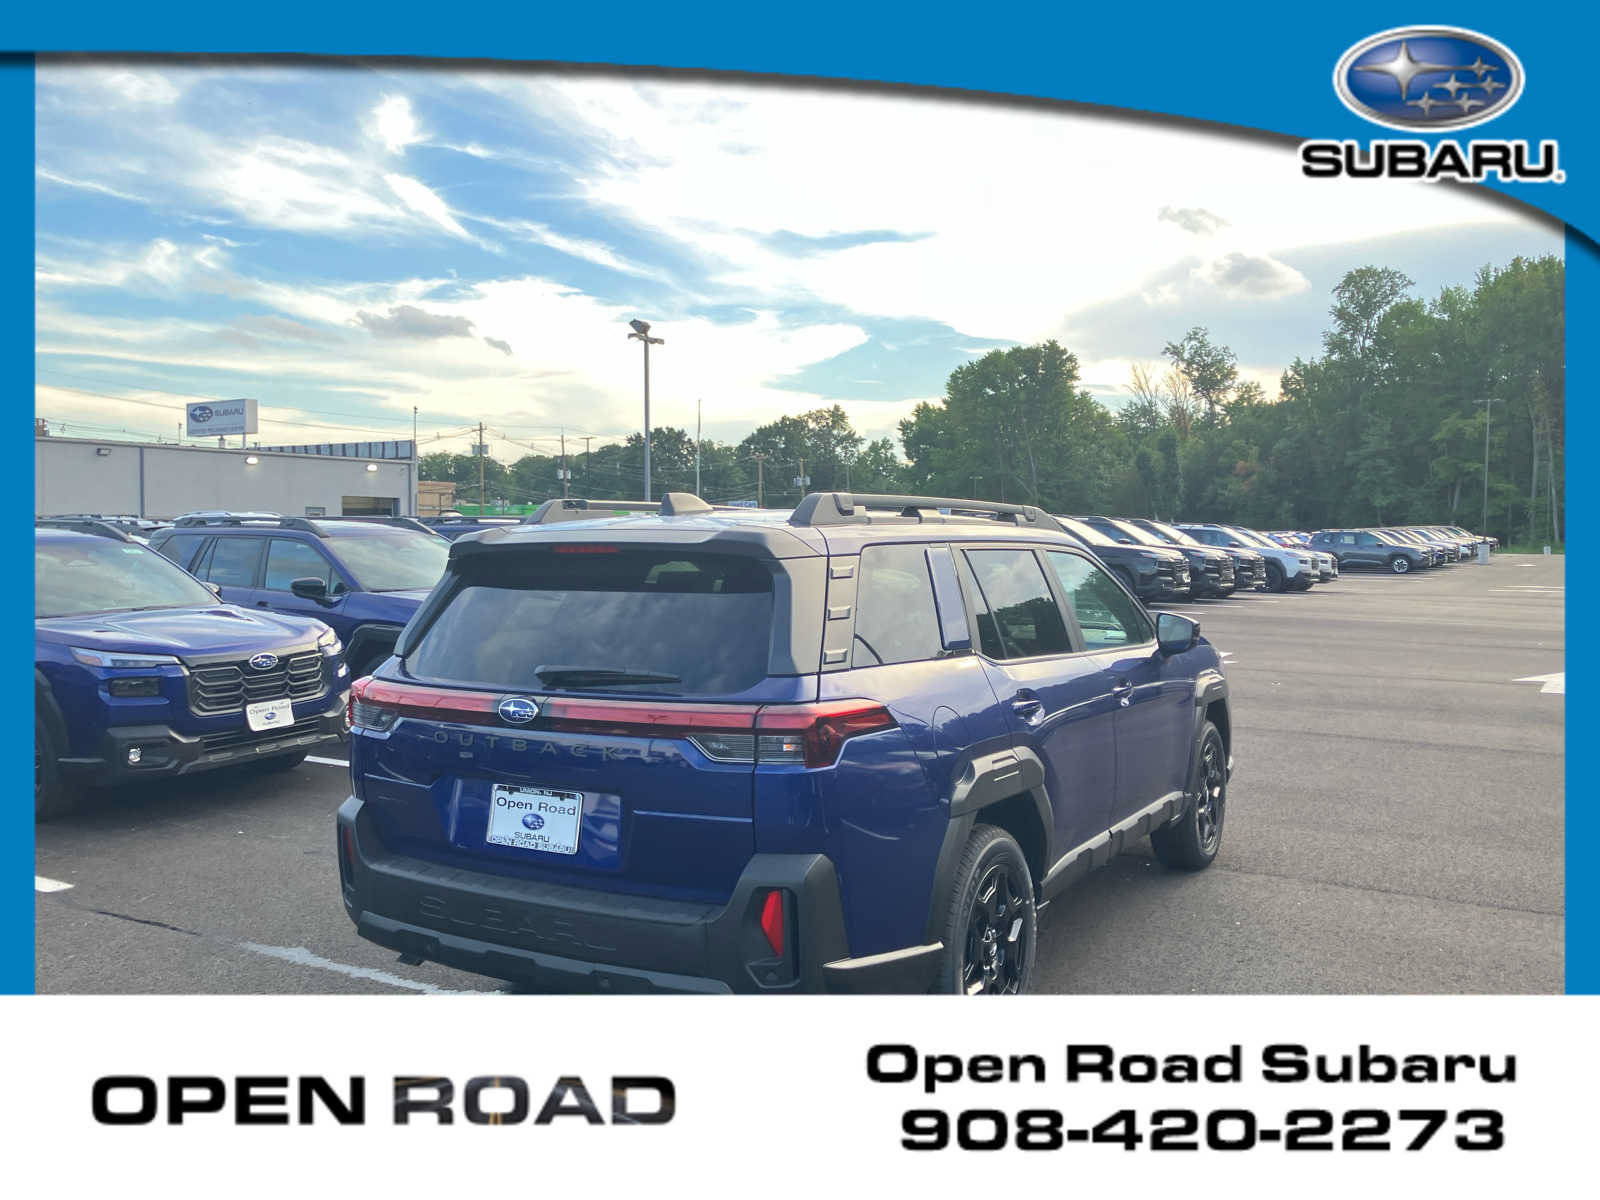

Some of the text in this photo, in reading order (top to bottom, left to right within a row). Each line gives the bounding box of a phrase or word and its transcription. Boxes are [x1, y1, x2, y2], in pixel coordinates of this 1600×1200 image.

[215, 407, 244, 417] SUBARU
[433, 730, 621, 761] OUTBACK
[496, 797, 577, 816] Open Road
[514, 831, 550, 843] SUBARU
